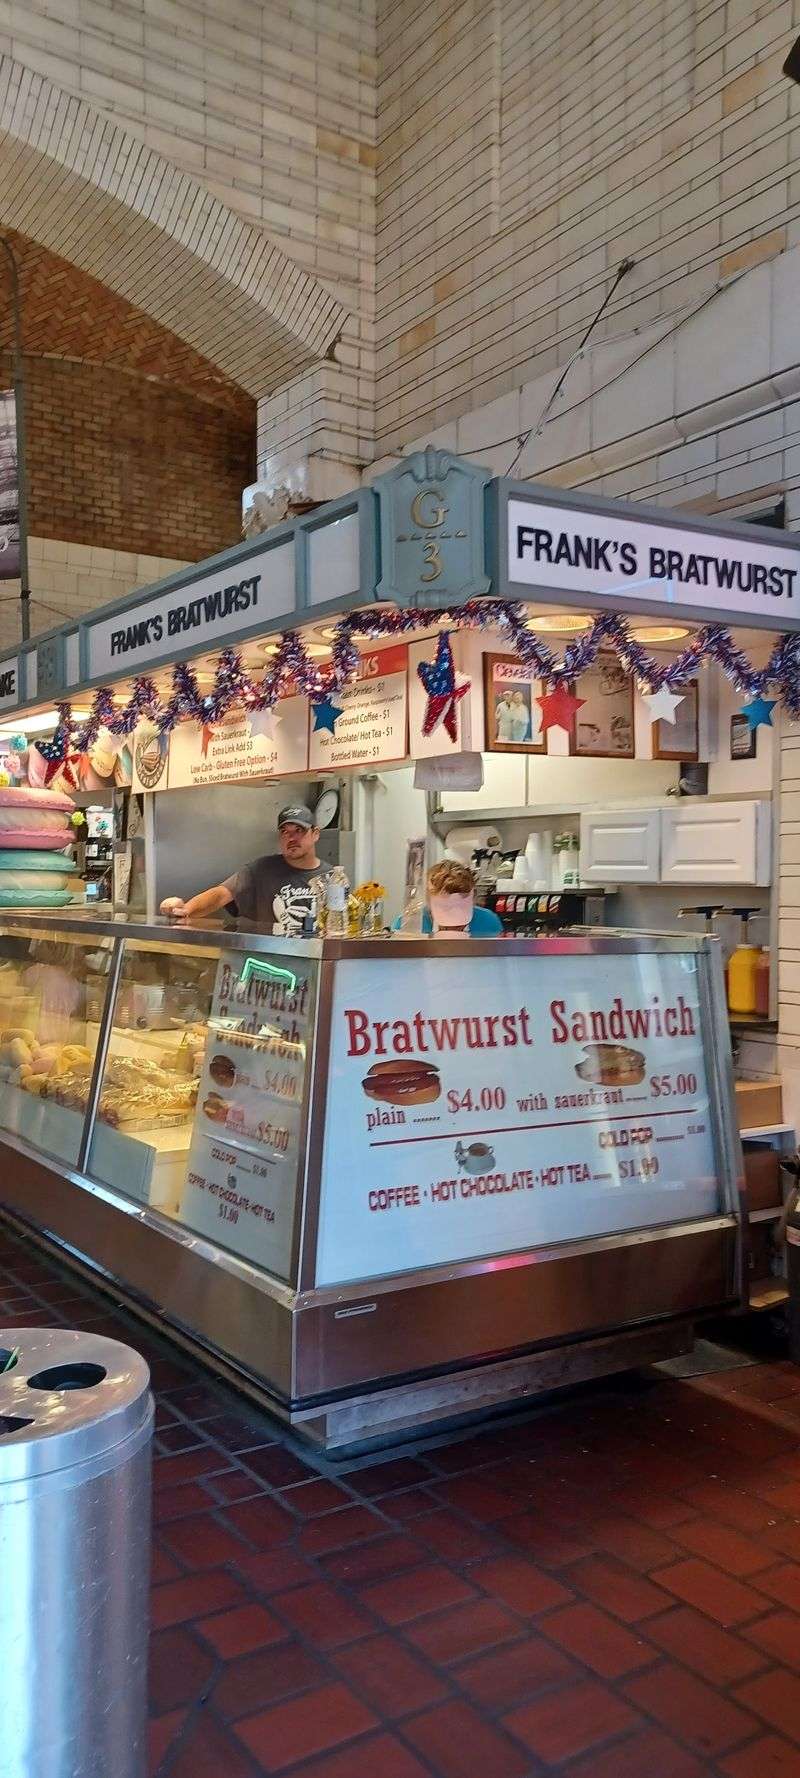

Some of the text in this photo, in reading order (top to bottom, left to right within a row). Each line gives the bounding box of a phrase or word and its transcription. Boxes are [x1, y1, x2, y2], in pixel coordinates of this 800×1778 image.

[411, 489, 449, 529] G
[420, 541, 444, 582] 3
[516, 525, 798, 598] FRANK'S BRATWURST
[110, 575, 262, 656] FRANK'S BRATWURST
[360, 711, 379, 723] Coffee
[360, 729, 371, 742] Hot
[371, 728, 382, 739] Tea
[216, 759, 234, 770] Gluten
[246, 755, 266, 768] Option
[344, 996, 696, 1057] Bratwurst Sandwich
[365, 1106, 407, 1131] plain
[447, 1086, 507, 1114] $4.00
[516, 1092, 548, 1113] with
[650, 1073, 697, 1098] $5.00
[367, 1156, 660, 1212] COFFEE HOT CHOCOLATE HOT TEA $1.00
